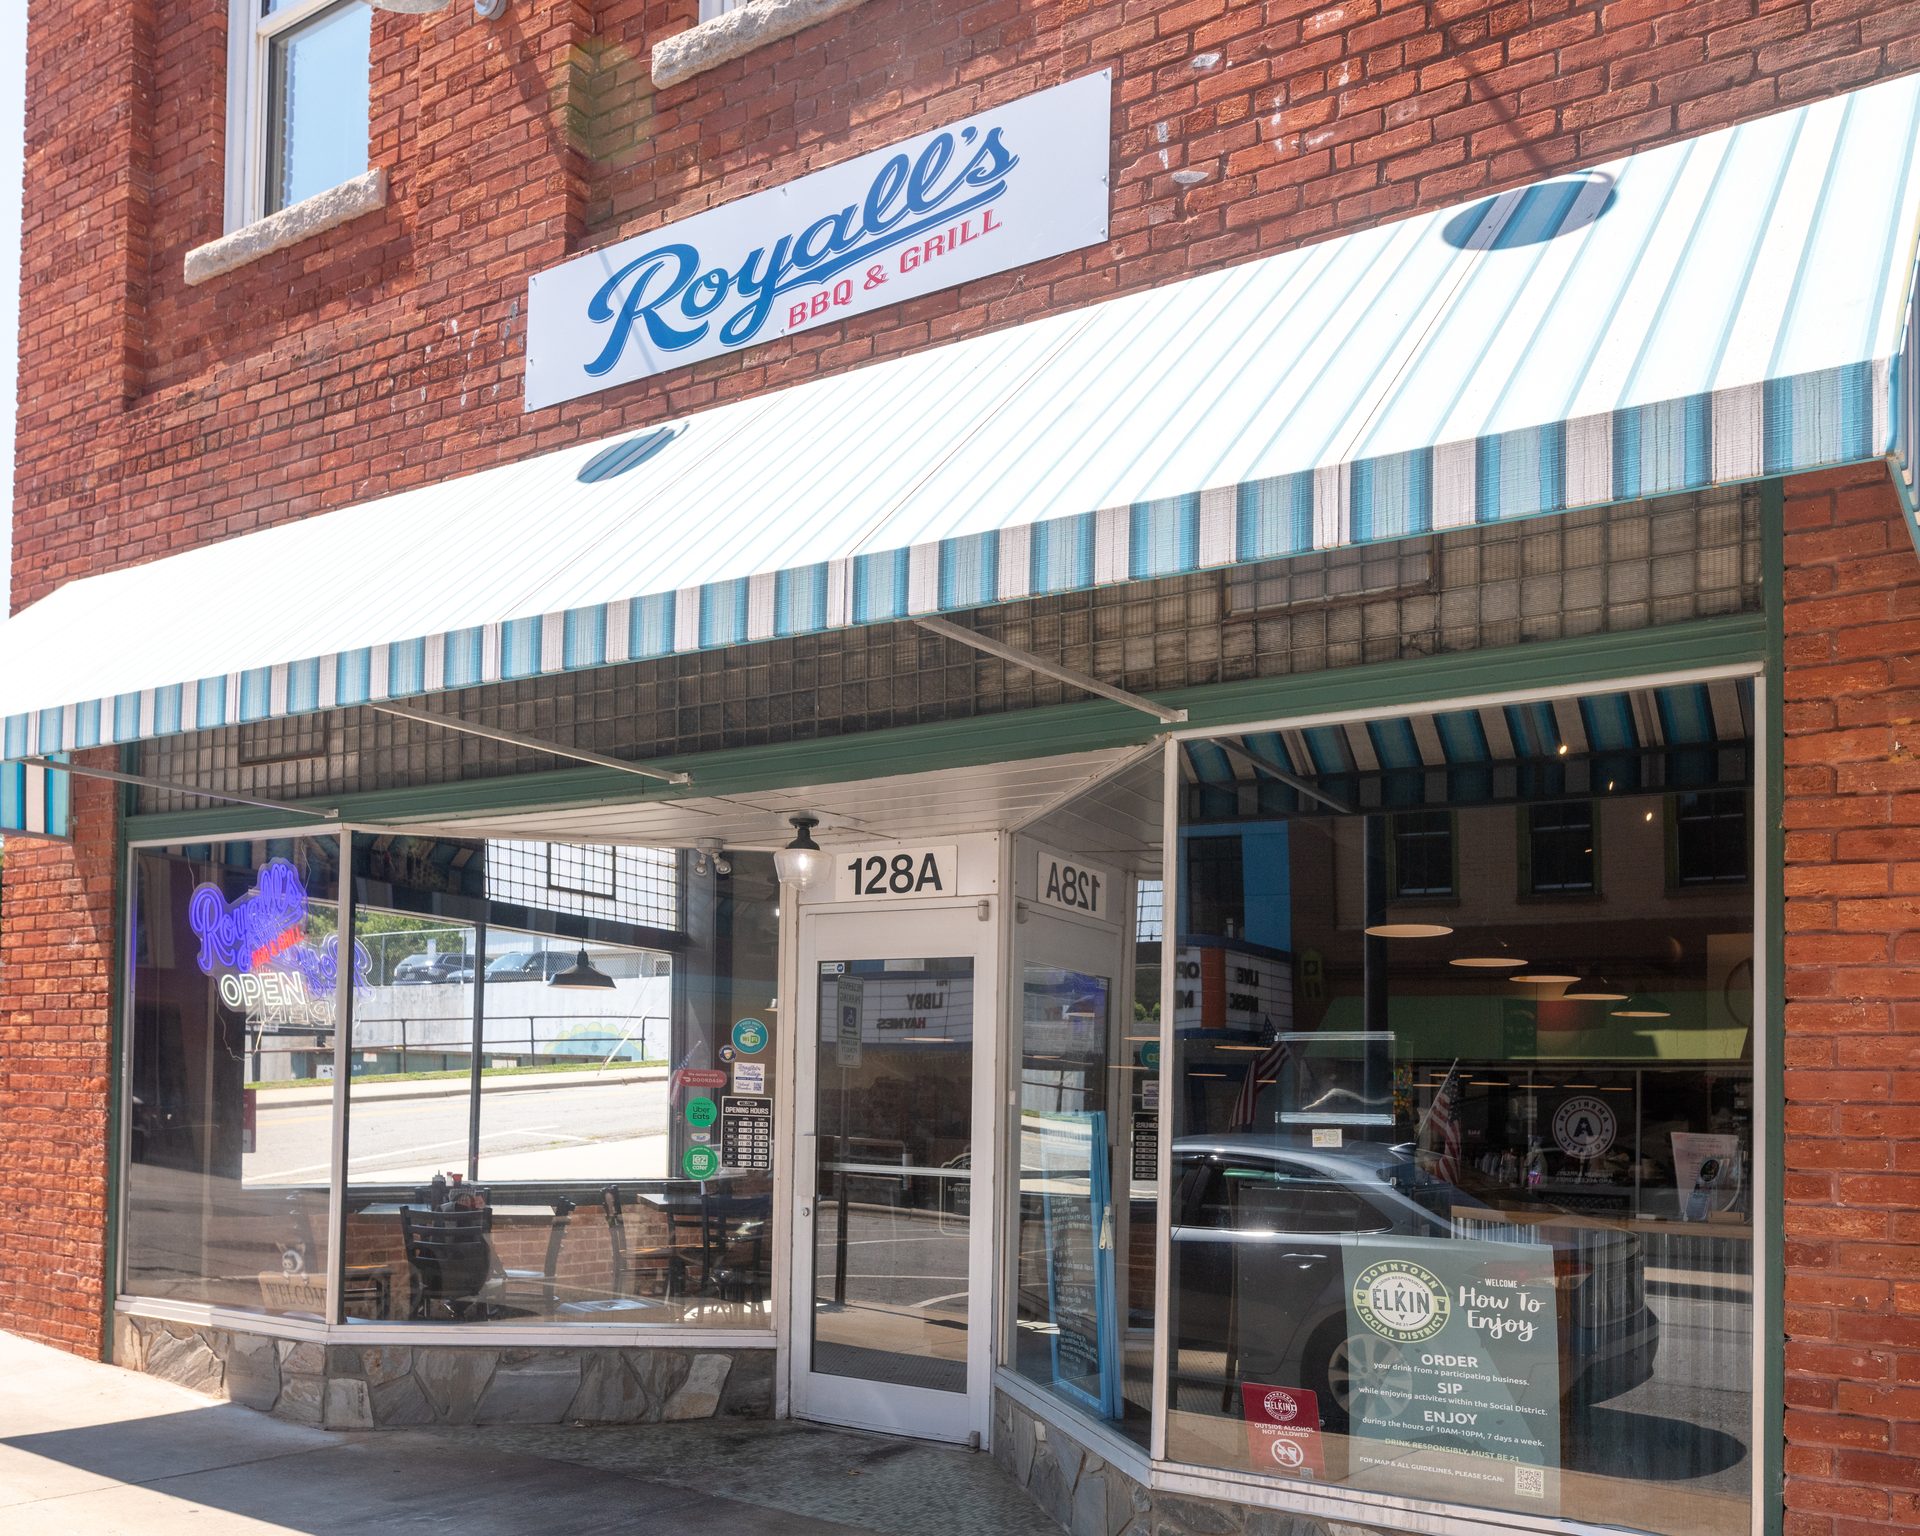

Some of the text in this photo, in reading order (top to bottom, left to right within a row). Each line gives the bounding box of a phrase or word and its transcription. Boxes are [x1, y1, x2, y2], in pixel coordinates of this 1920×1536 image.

[583, 125, 1020, 377] Royall's
[788, 208, 1002, 329] BBQ & GRILL
[848, 852, 943, 896] 128A
[191, 864, 303, 973] Royall's
[221, 971, 308, 1007] OPEN
[692, 1105, 710, 1113] Uber
[725, 1106, 749, 1114] OPENING
[1362, 1263, 1439, 1290] DOWNTOWN
[1485, 1278, 1518, 1289] WELCOME
[265, 1282, 327, 1309] WELCOM
[1372, 1288, 1430, 1315] ELKIN
[1459, 1285, 1546, 1313] How To
[1361, 1307, 1444, 1341] SOCIAL DISTRICT
[1467, 1310, 1539, 1342] Enjoy
[1373, 1362, 1391, 1370] your
[1392, 1363, 1412, 1373] drink
[1413, 1365, 1433, 1375] from
[1440, 1370, 1491, 1383] participating
[1492, 1374, 1530, 1386] business.
[1421, 1354, 1479, 1368] ORDER
[1358, 1386, 1379, 1395] while
[1380, 1389, 1412, 1400] enjoying
[1448, 1396, 1473, 1407] within
[1474, 1400, 1488, 1409] the
[1489, 1401, 1514, 1412] Social
[1515, 1404, 1548, 1416] District.
[1437, 1382, 1463, 1394] SIP
[1271, 1402, 1291, 1412] ELKIN
[1423, 1410, 1478, 1425] ENJOY
[1254, 1422, 1315, 1433] OUTSIDE ALCOHOL
[1277, 1430, 1309, 1438] ALLOWED
[1362, 1416, 1386, 1428] during
[1388, 1419, 1401, 1428] the
[1402, 1421, 1424, 1431] hours
[1425, 1424, 1435, 1432] of
[1436, 1425, 1486, 1440] 10AM-10PM,
[1487, 1432, 1492, 1440] 7
[1493, 1433, 1512, 1443] days
[1520, 1437, 1545, 1447] week.
[1384, 1437, 1520, 1462] DRINK RESPONSIBLY, MUST BE 21
[1359, 1456, 1373, 1464] FOR
[1374, 1458, 1390, 1466] MAP
[1411, 1464, 1454, 1476] GUIDELINES,
[1454, 1470, 1482, 1480] PLEASE
[1483, 1474, 1505, 1483] SCAN:
